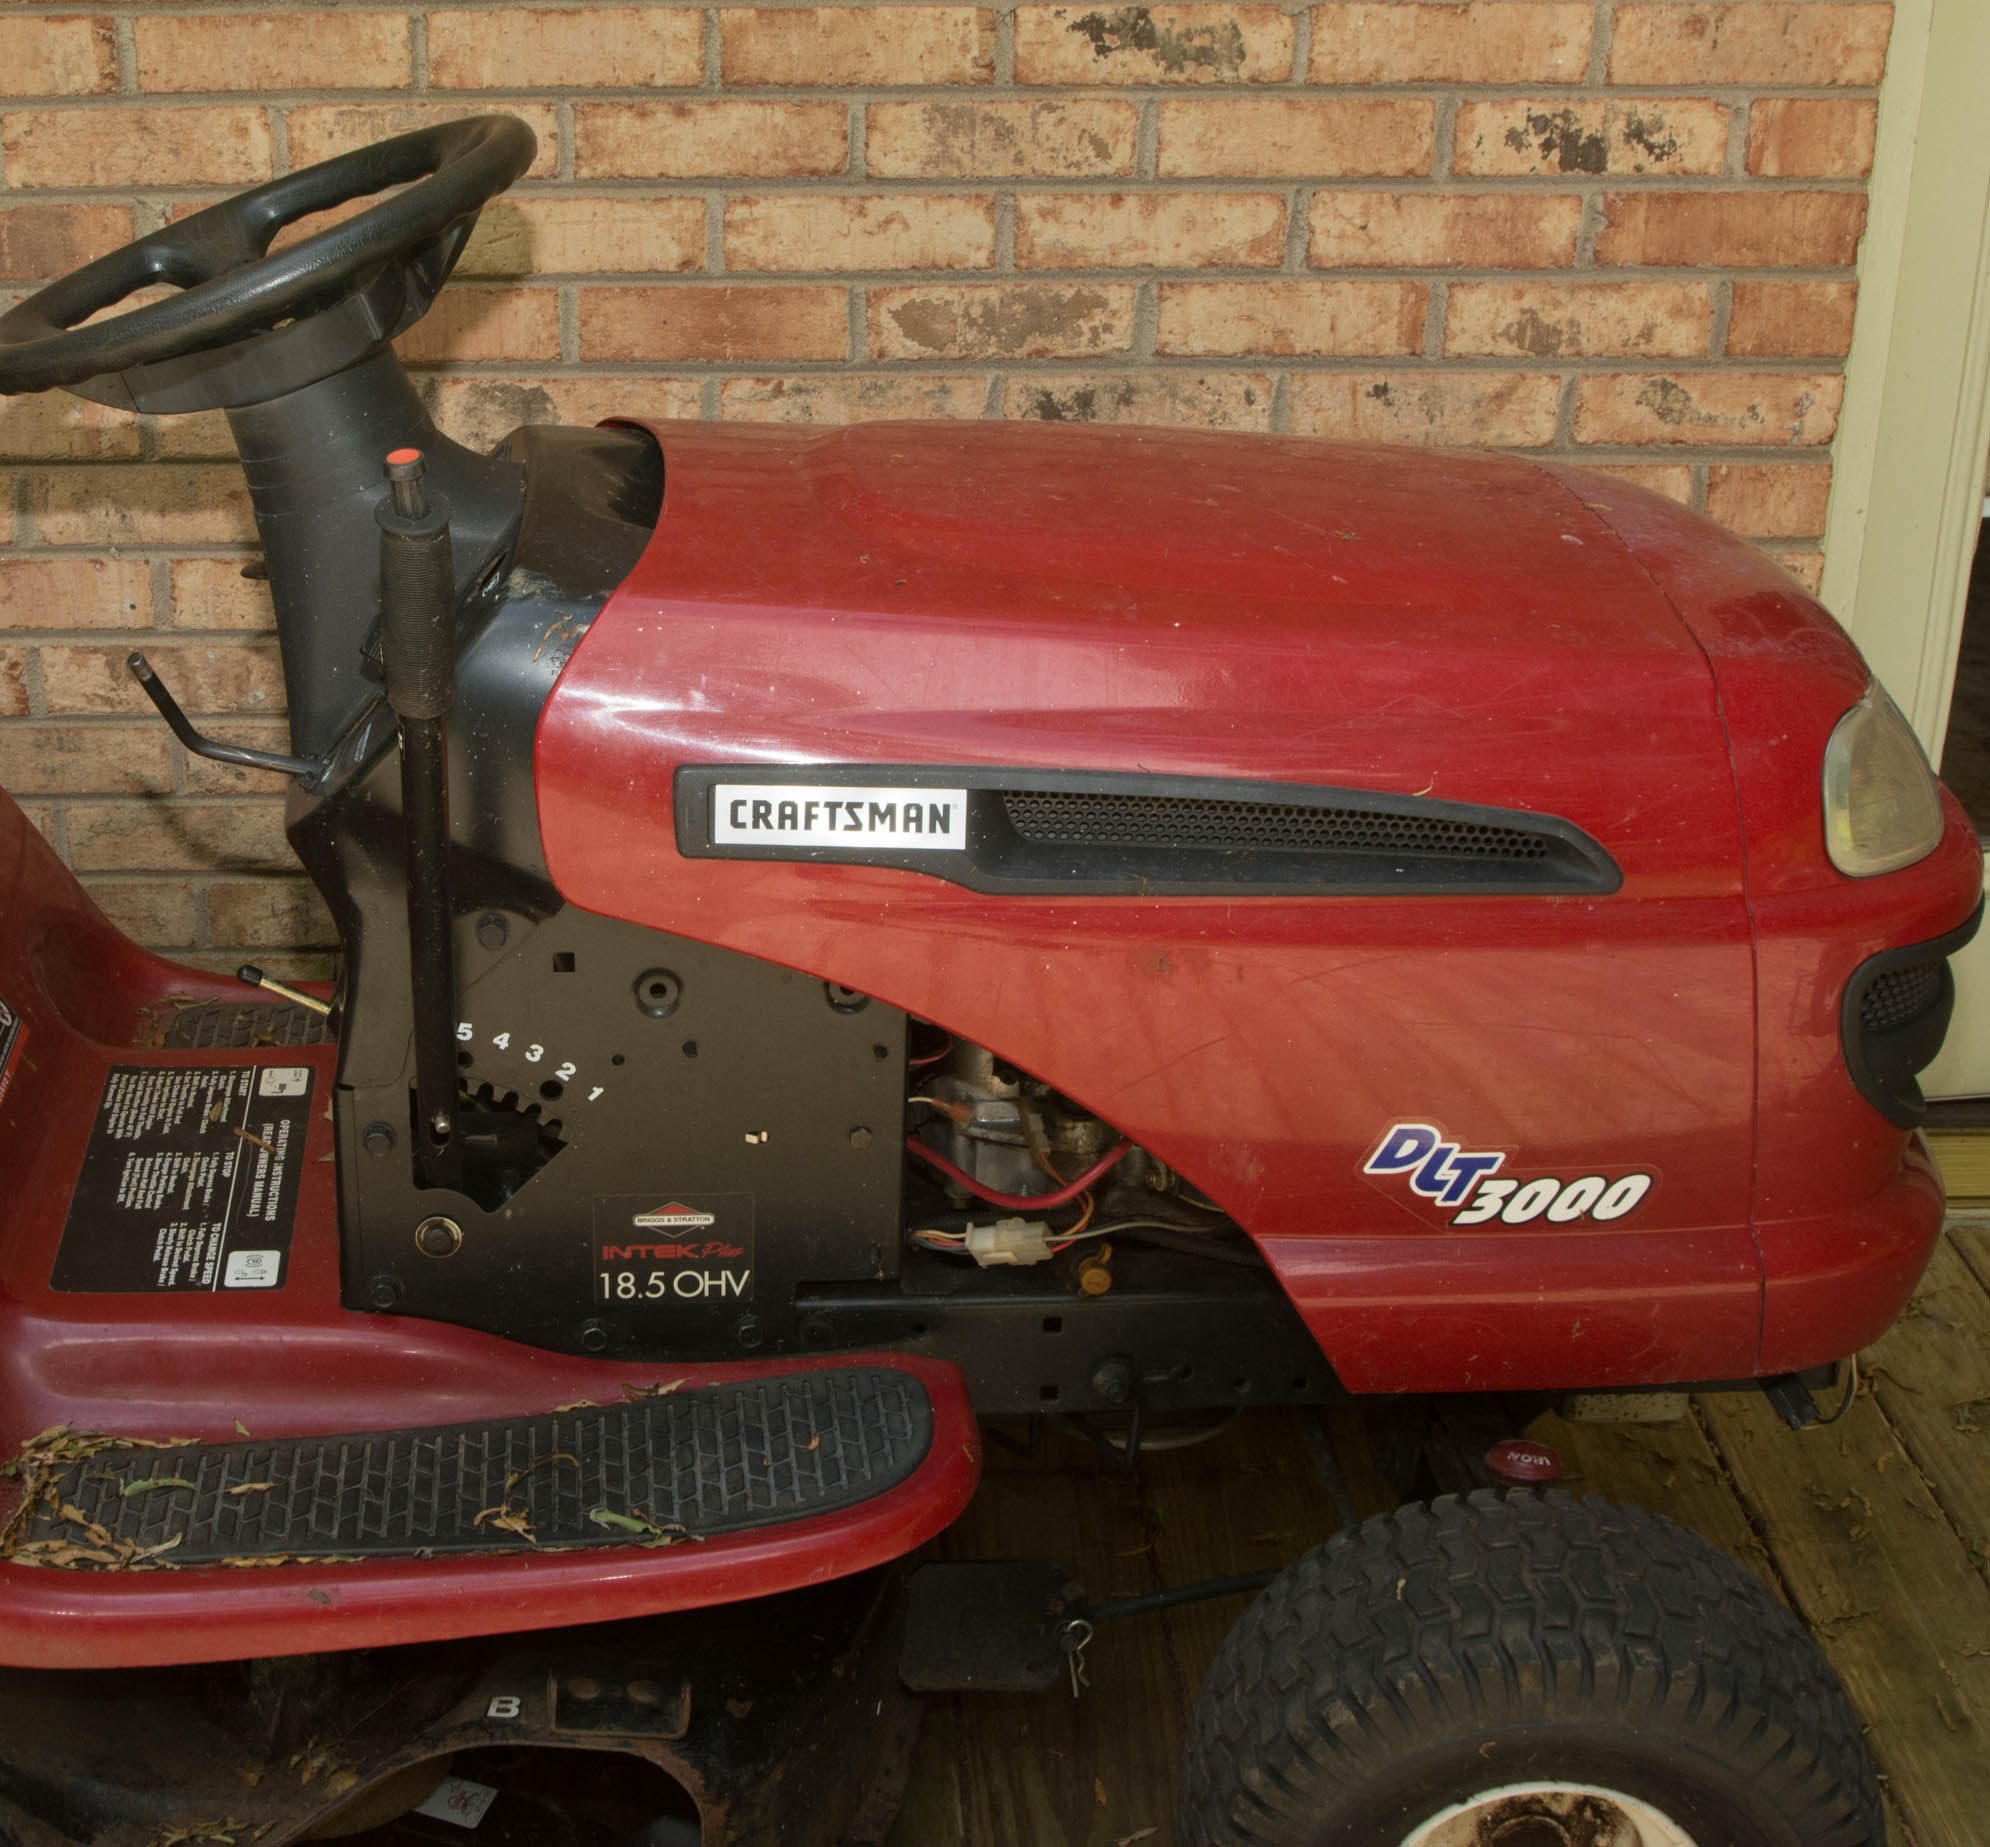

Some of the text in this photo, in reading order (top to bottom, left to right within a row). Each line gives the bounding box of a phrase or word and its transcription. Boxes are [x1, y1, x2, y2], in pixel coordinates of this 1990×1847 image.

[729, 799, 951, 834] CRAFTSMAN
[456, 1022, 605, 1102] 5 4 3 2 1
[237, 1079, 248, 1096] START
[221, 1151, 234, 1177] TO STOP
[263, 1119, 290, 1220] OPERATING INSTRUCTIONS
[1363, 1123, 1654, 1227] DLT 3000
[245, 1180, 264, 1216] MANUAL)
[637, 1216, 665, 1224] BRIGGS
[673, 1215, 711, 1223] STRATTON
[201, 1222, 221, 1283] TO CHANGE SPEED
[602, 1241, 745, 1260] INTEK Plus
[600, 1270, 751, 1300] 18.5 OHV
[486, 1695, 522, 1719] B
